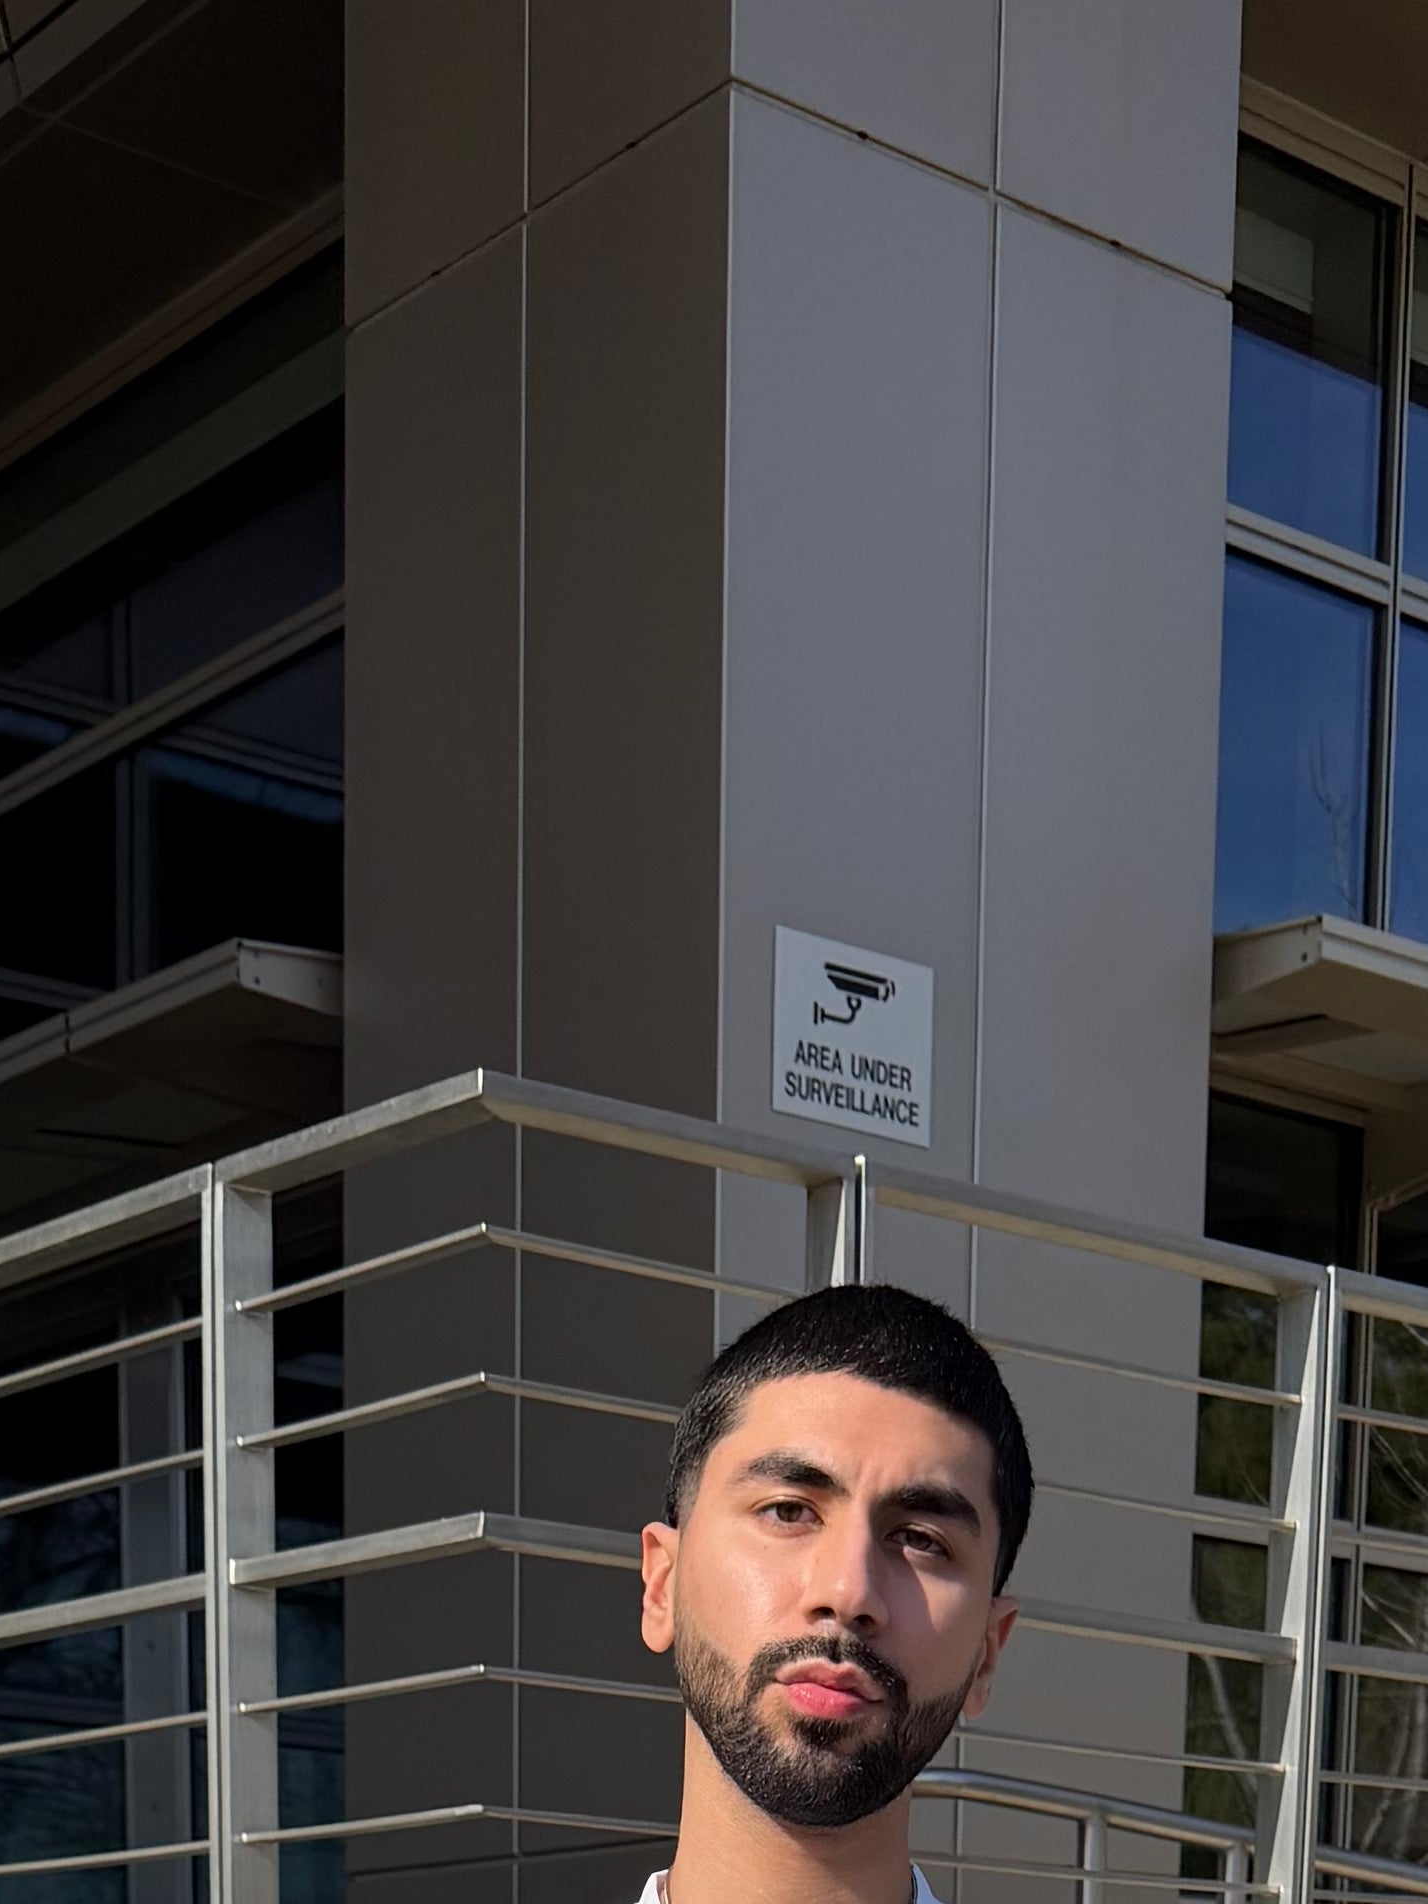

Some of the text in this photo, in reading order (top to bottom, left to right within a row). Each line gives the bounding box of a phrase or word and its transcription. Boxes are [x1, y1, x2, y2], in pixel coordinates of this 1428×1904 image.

[793, 1039, 913, 1093] AREA UNDER
[784, 1070, 920, 1128] SURVEILLANCE
